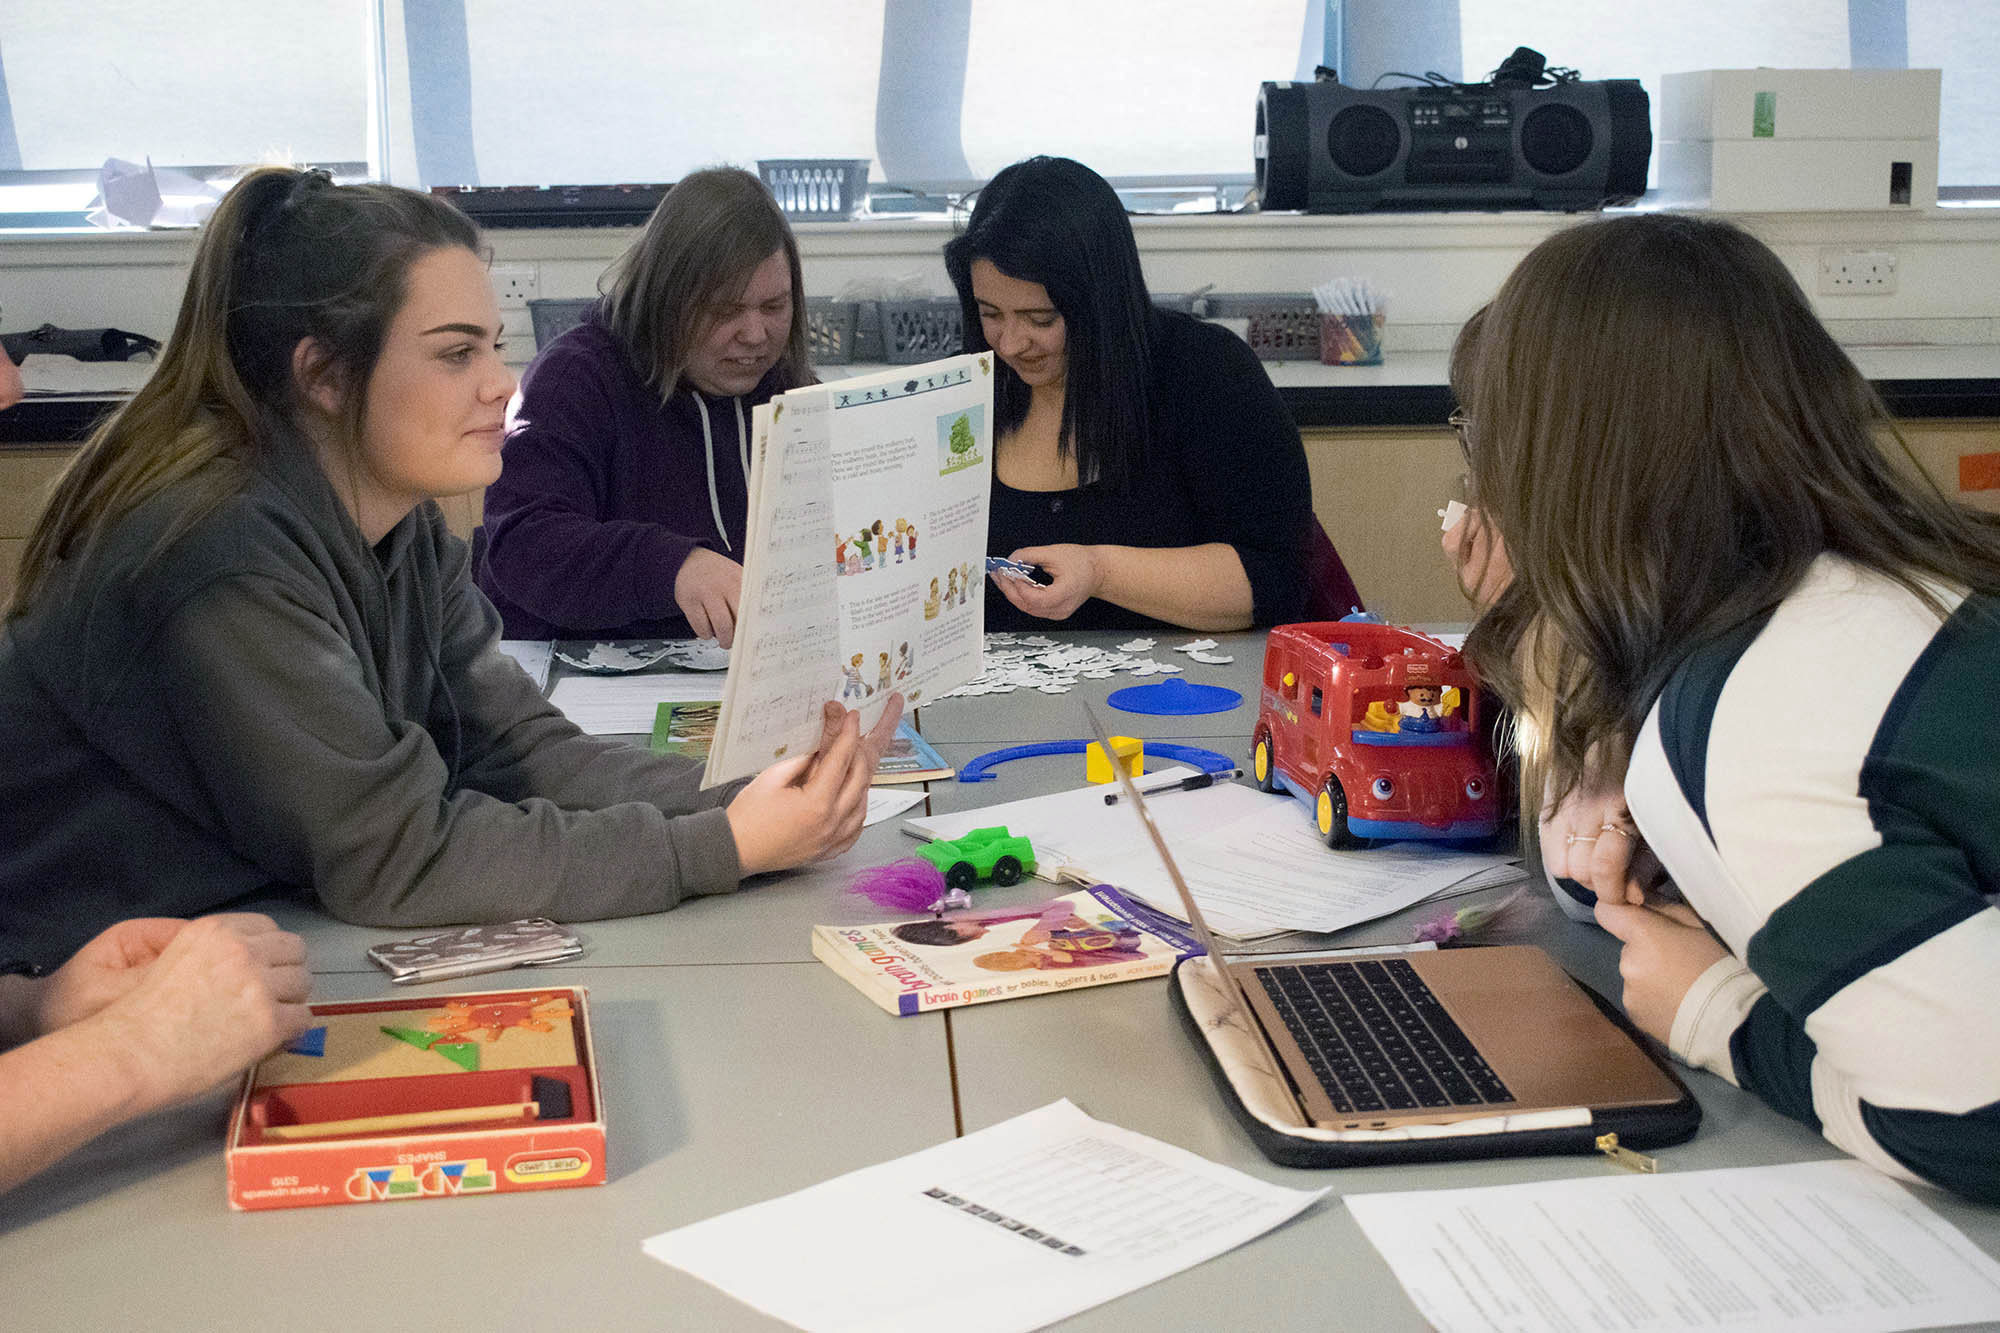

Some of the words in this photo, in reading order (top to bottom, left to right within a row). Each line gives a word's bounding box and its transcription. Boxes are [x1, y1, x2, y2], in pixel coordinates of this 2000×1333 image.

[839, 929, 905, 966] games
[877, 964, 933, 993] brain
[924, 989, 959, 1006] brain
[963, 985, 1002, 1004] games
[1055, 975, 1088, 989] toddlers
[1090, 973, 1097, 982] &
[397, 1151, 447, 1164] SHAPES
[242, 1187, 289, 1200] upwards
[290, 1184, 320, 1196] years
[321, 1186, 330, 1195] 4
